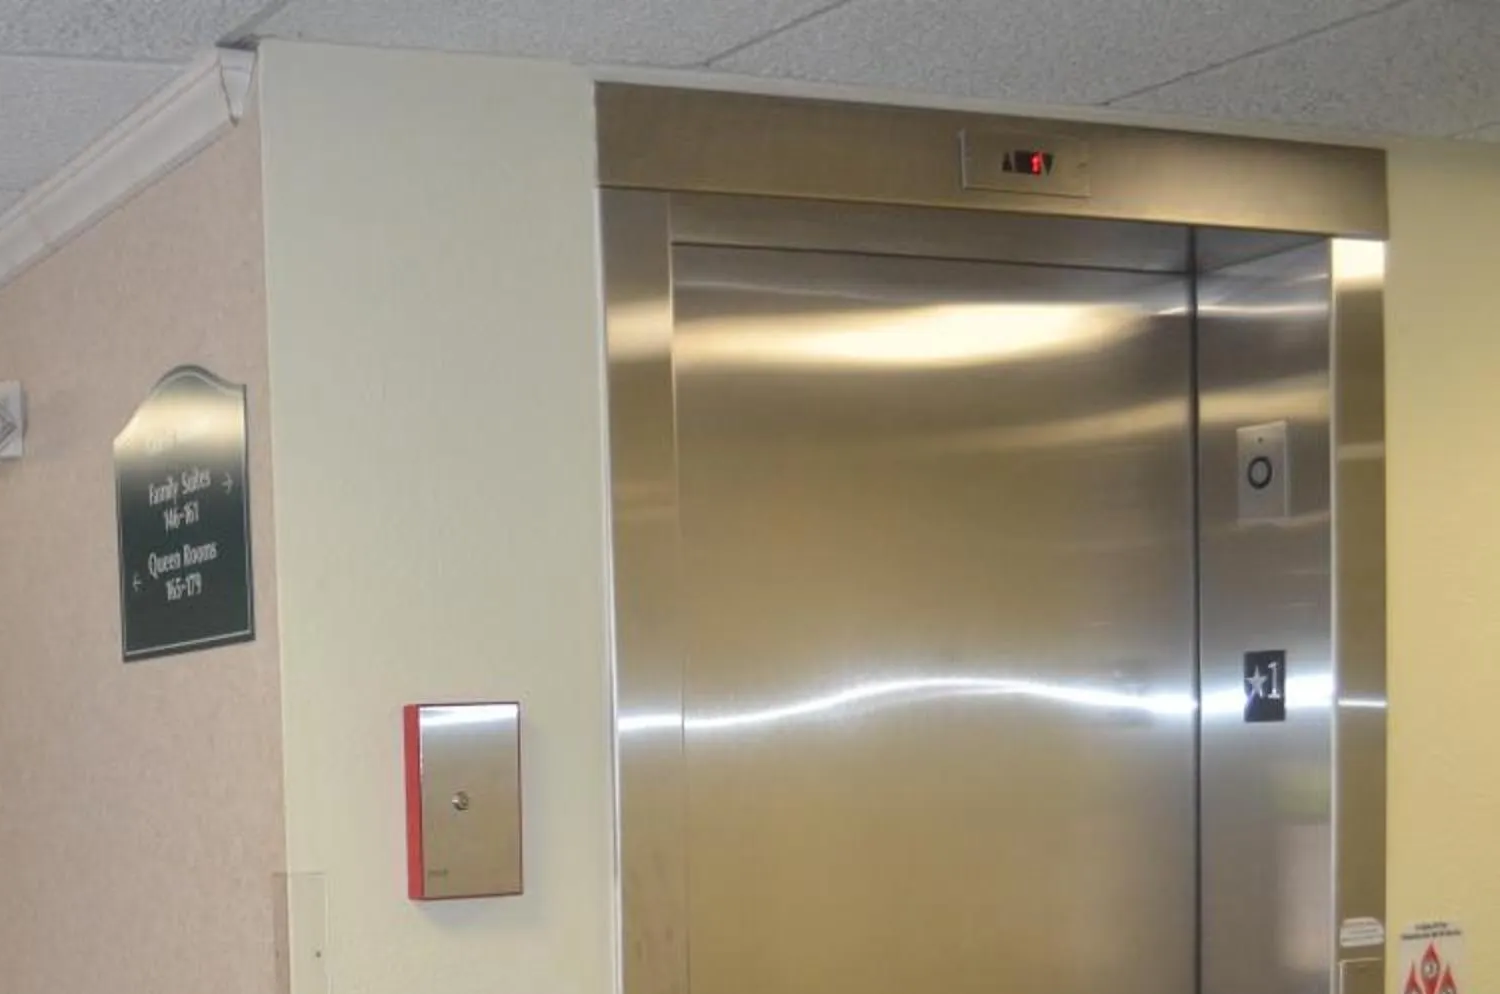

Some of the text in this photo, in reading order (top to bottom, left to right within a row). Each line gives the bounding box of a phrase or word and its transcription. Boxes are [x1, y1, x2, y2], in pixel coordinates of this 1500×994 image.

[149, 467, 211, 506] Family Suites
[148, 542, 217, 579] Queen Rooms
[1268, 661, 1280, 699] 1
